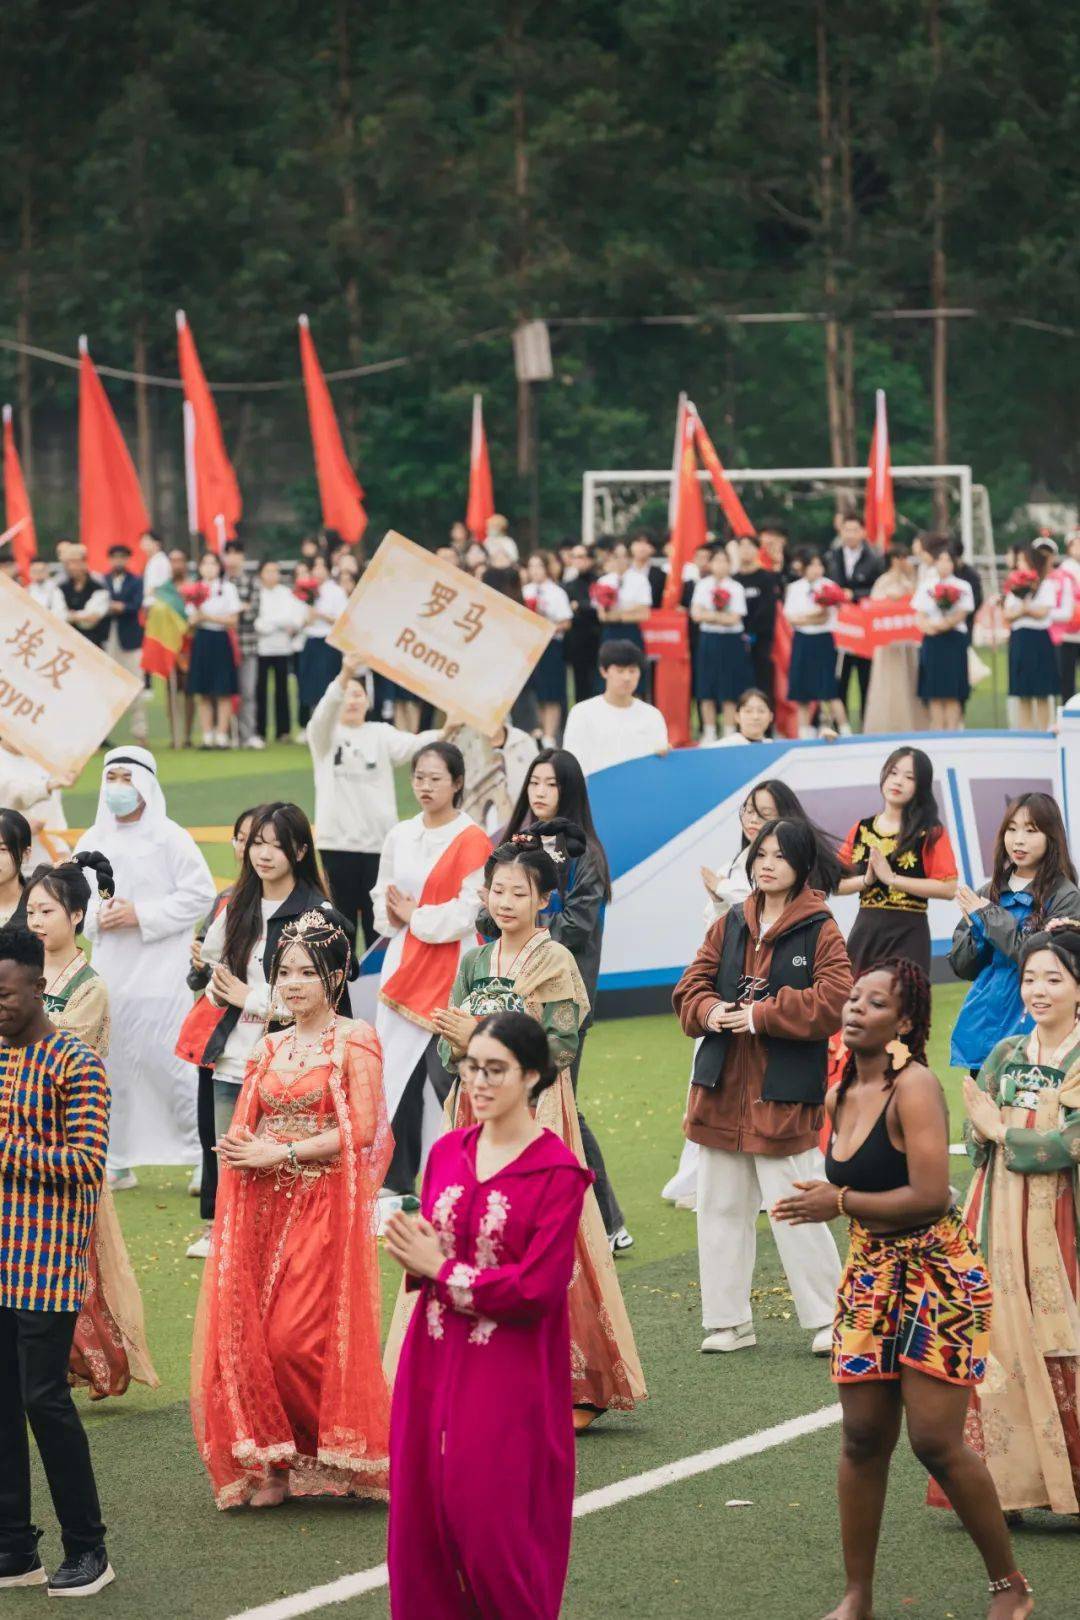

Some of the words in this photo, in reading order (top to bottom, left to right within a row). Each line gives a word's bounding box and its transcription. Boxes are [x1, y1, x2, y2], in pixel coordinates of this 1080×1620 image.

[417, 581, 486, 643] 罗马
[5, 620, 75, 689] 埃及
[396, 627, 460, 679] Rome
